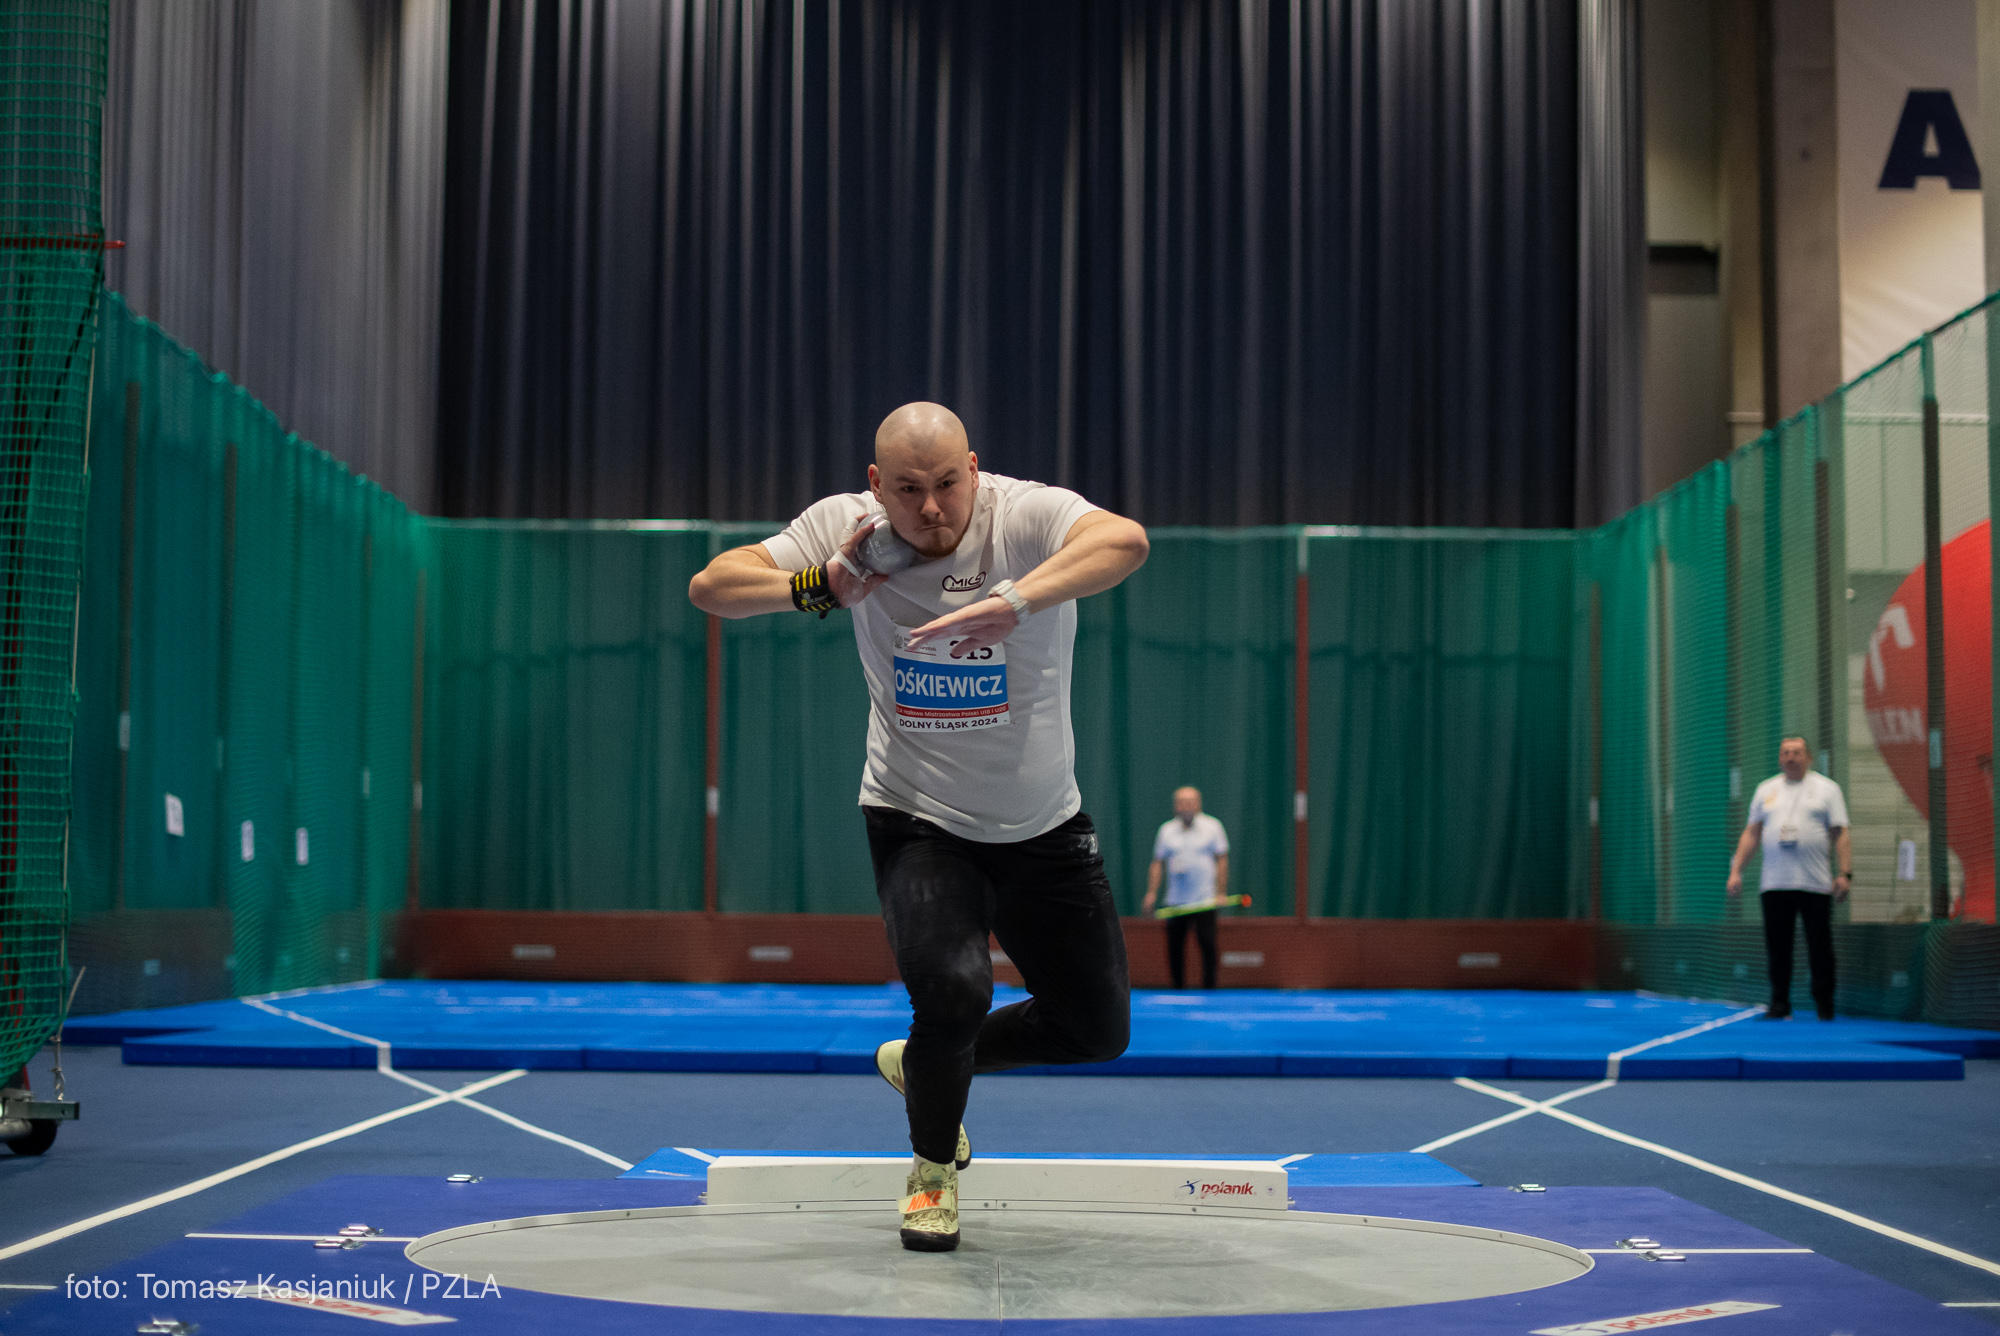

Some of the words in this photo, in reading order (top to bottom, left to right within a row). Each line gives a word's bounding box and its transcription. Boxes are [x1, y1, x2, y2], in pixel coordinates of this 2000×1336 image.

[895, 667, 1003, 698] OŚKIEWICZ
[900, 719, 932, 729] DOLNY
[935, 720, 969, 730] ŚLĄSK
[971, 717, 998, 727] 2024
[906, 1190, 945, 1213] NIKE
